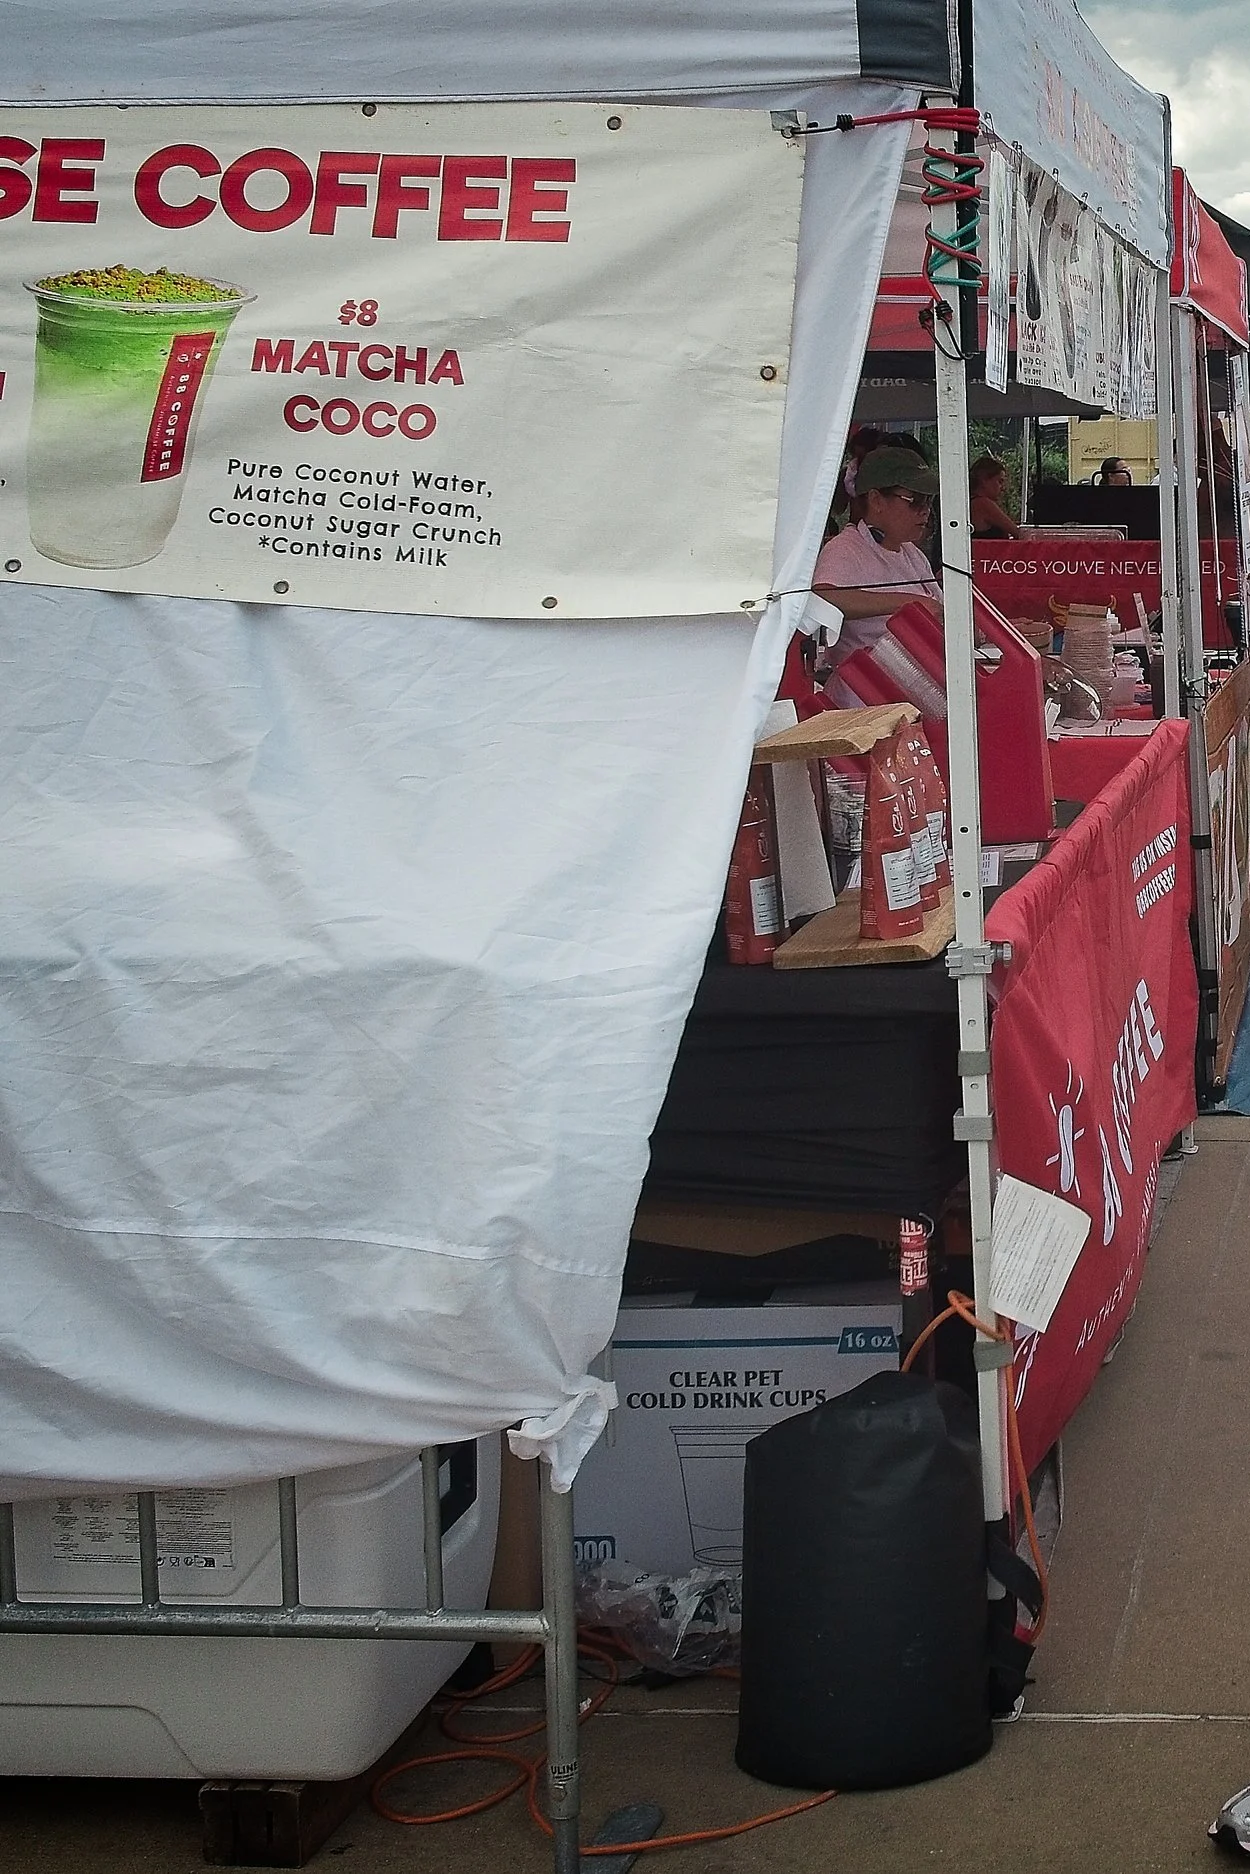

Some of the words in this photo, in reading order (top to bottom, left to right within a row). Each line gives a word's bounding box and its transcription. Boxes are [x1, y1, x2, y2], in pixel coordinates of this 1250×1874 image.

[134, 143, 577, 243] COFFEE
[338, 299, 379, 327] $8
[251, 338, 464, 386] MATCHA
[283, 394, 437, 441] COCO
[160, 401, 182, 471] COFFEE
[226, 458, 283, 479] Pure
[295, 463, 400, 487] Coconut
[412, 470, 493, 498] Water,
[233, 483, 327, 507] Matcha
[339, 491, 483, 523] Cold-Foam,
[208, 507, 315, 531] Coconut
[326, 515, 401, 539] Sugar
[412, 522, 502, 546] Crunch
[395, 545, 448, 567] Milk
[980, 559, 1037, 575] TACOS
[1041, 559, 1105, 575] YOU'VE
[1110, 561, 1162, 575] NEVE
[844, 1332, 866, 1349] 16
[871, 1334, 894, 1348] oz
[669, 1371, 738, 1388] CLEAR
[743, 1370, 784, 1386] PET
[626, 1392, 686, 1410] COLD
[693, 1391, 765, 1410] DRINK
[769, 1389, 827, 1407] CUPS
[550, 1761, 579, 1775] ULINE
